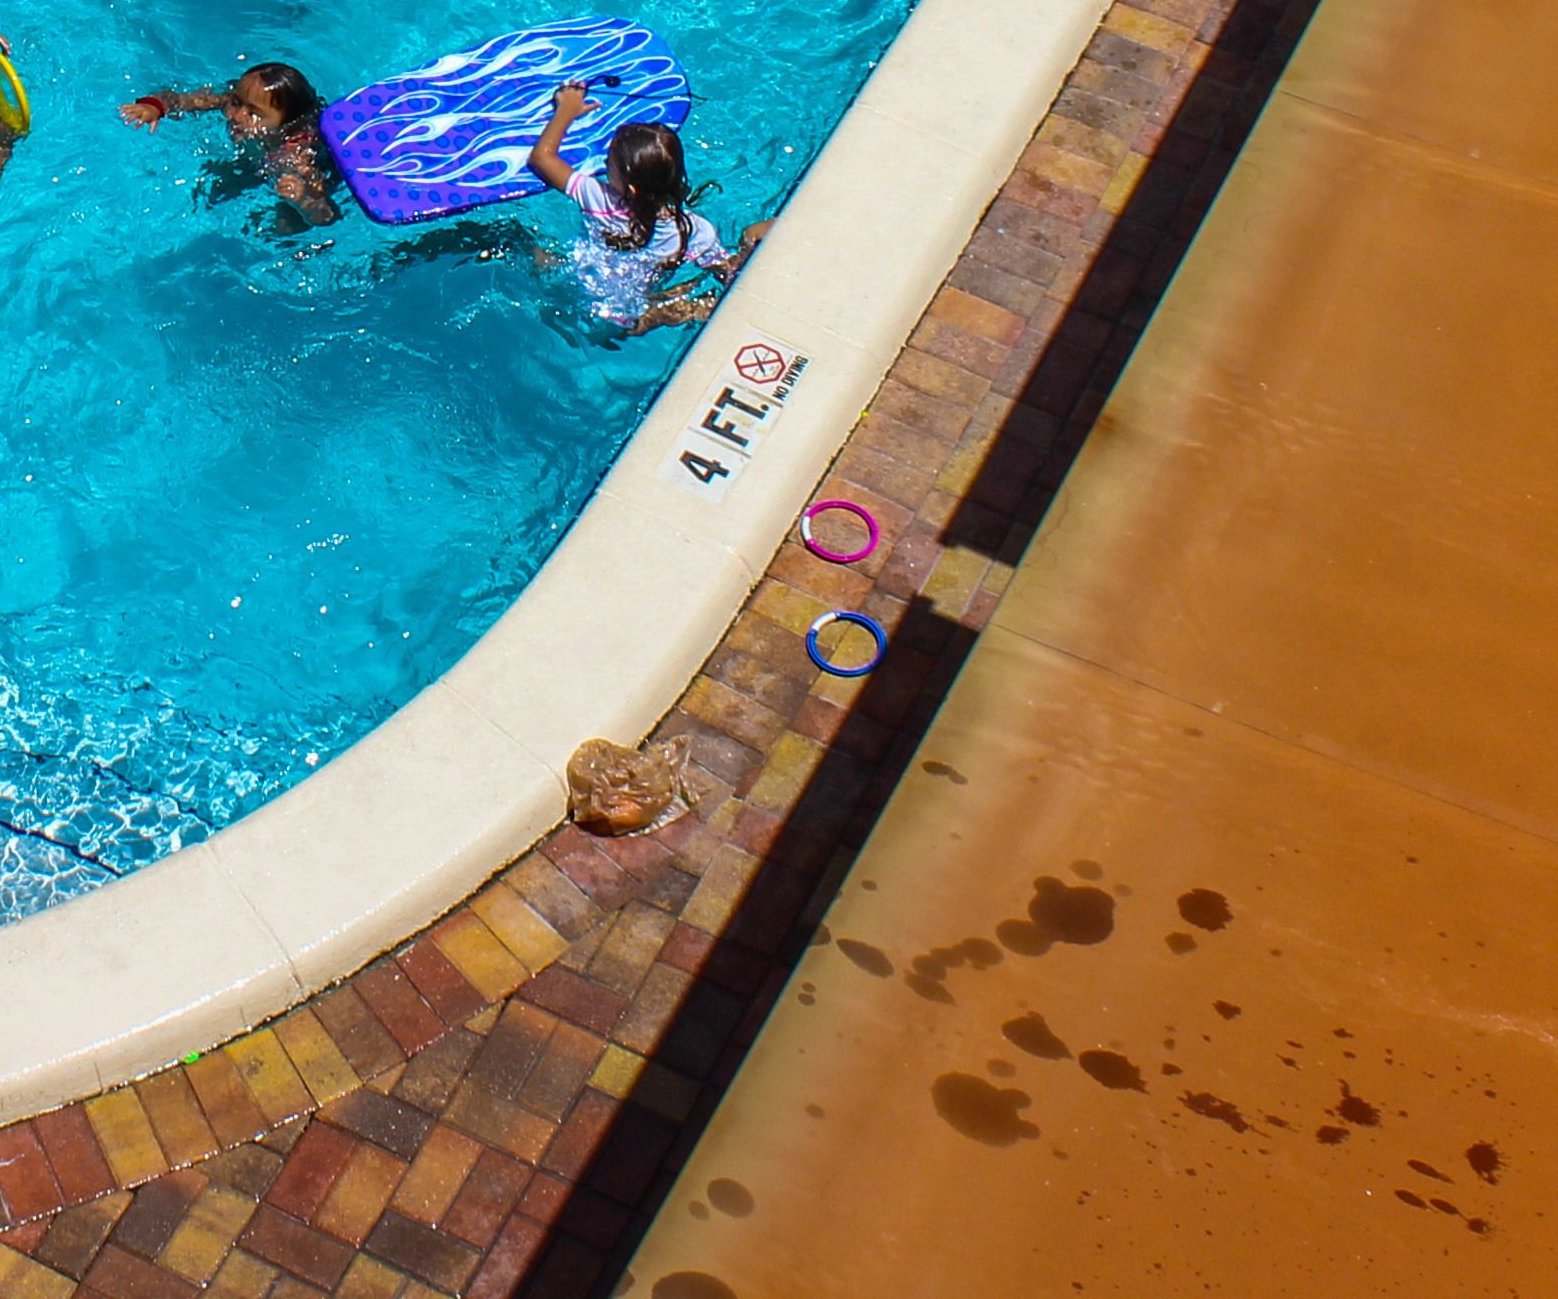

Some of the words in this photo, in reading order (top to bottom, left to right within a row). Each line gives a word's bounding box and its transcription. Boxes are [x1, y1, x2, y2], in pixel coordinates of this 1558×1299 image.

[772, 385, 789, 401] NO
[785, 355, 809, 387] DIVING
[701, 386, 770, 448] FT.
[679, 450, 730, 484] 4
